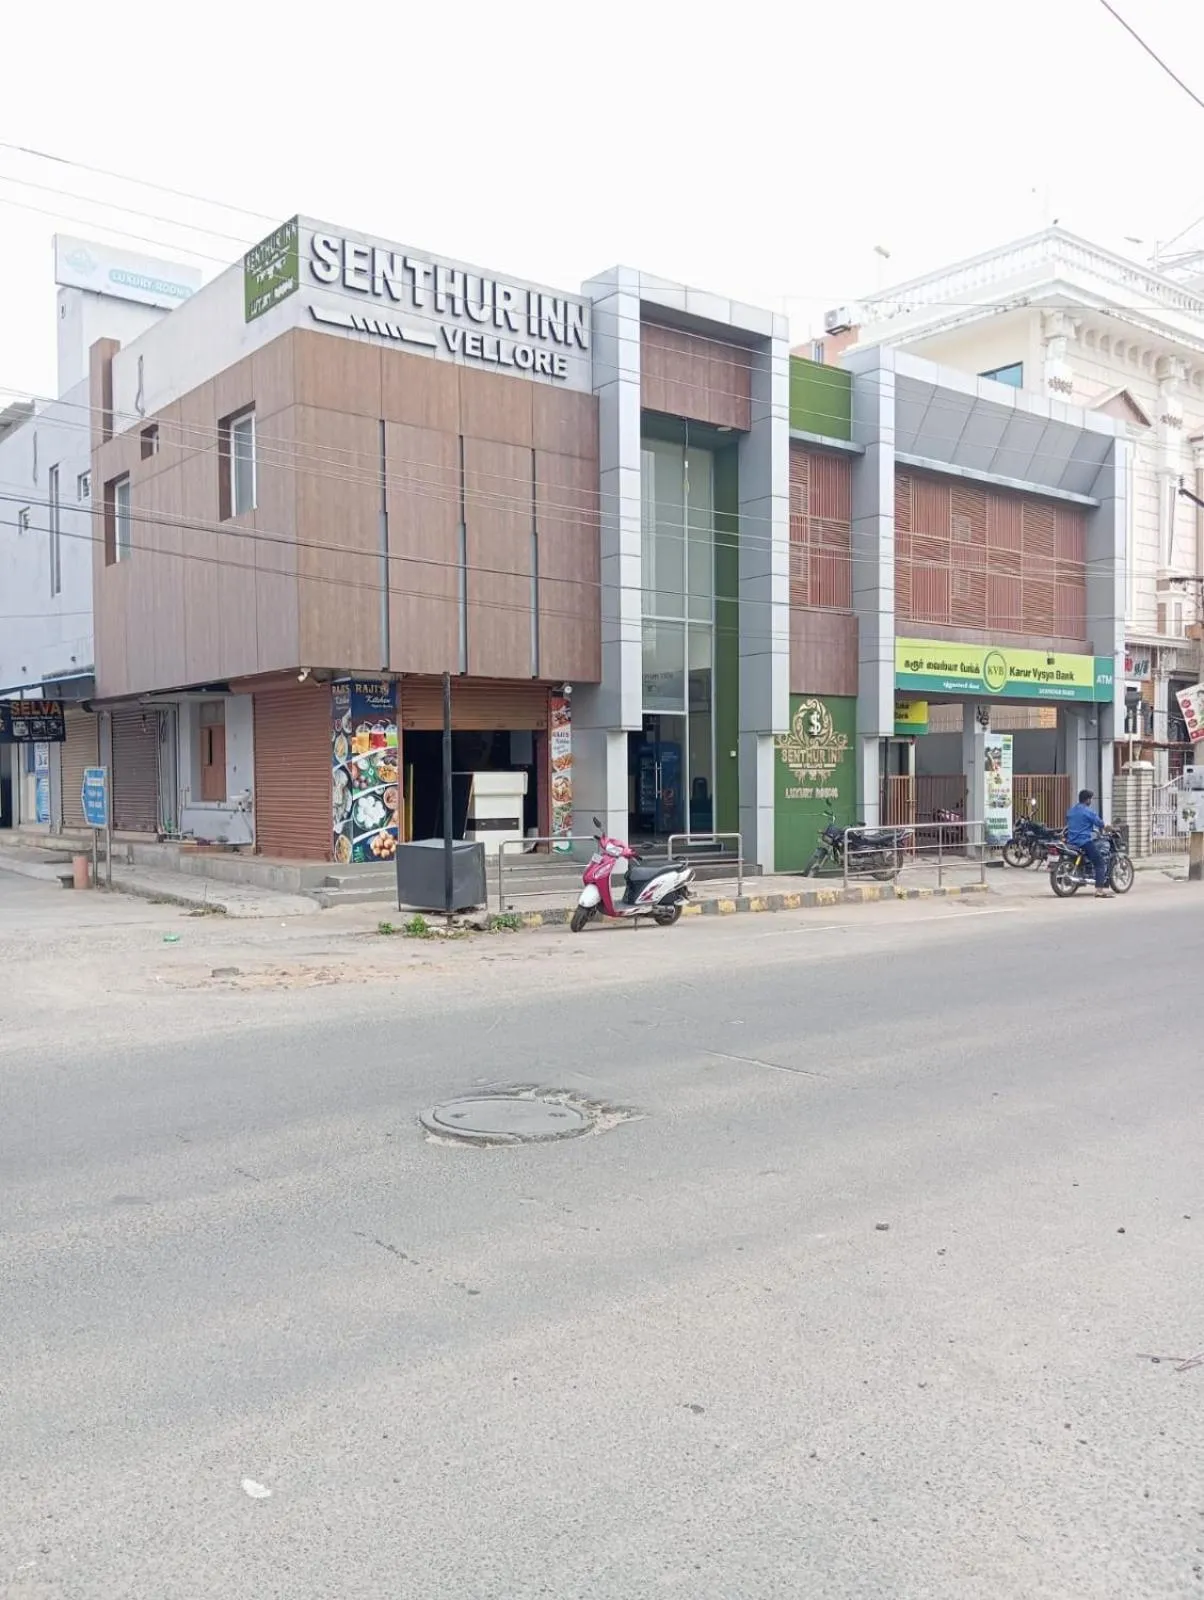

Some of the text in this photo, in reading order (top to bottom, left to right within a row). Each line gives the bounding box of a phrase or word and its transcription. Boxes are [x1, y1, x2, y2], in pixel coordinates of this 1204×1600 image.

[310, 231, 589, 350] SENTHUR INN
[441, 325, 570, 380] VELLORE
[987, 665, 1004, 677] KVB
[1009, 666, 1075, 682] Karur Vysya Bank
[1096, 674, 1113, 685] ATM
[11, 701, 61, 716] SELVA
[782, 749, 825, 763] SENTHUR
